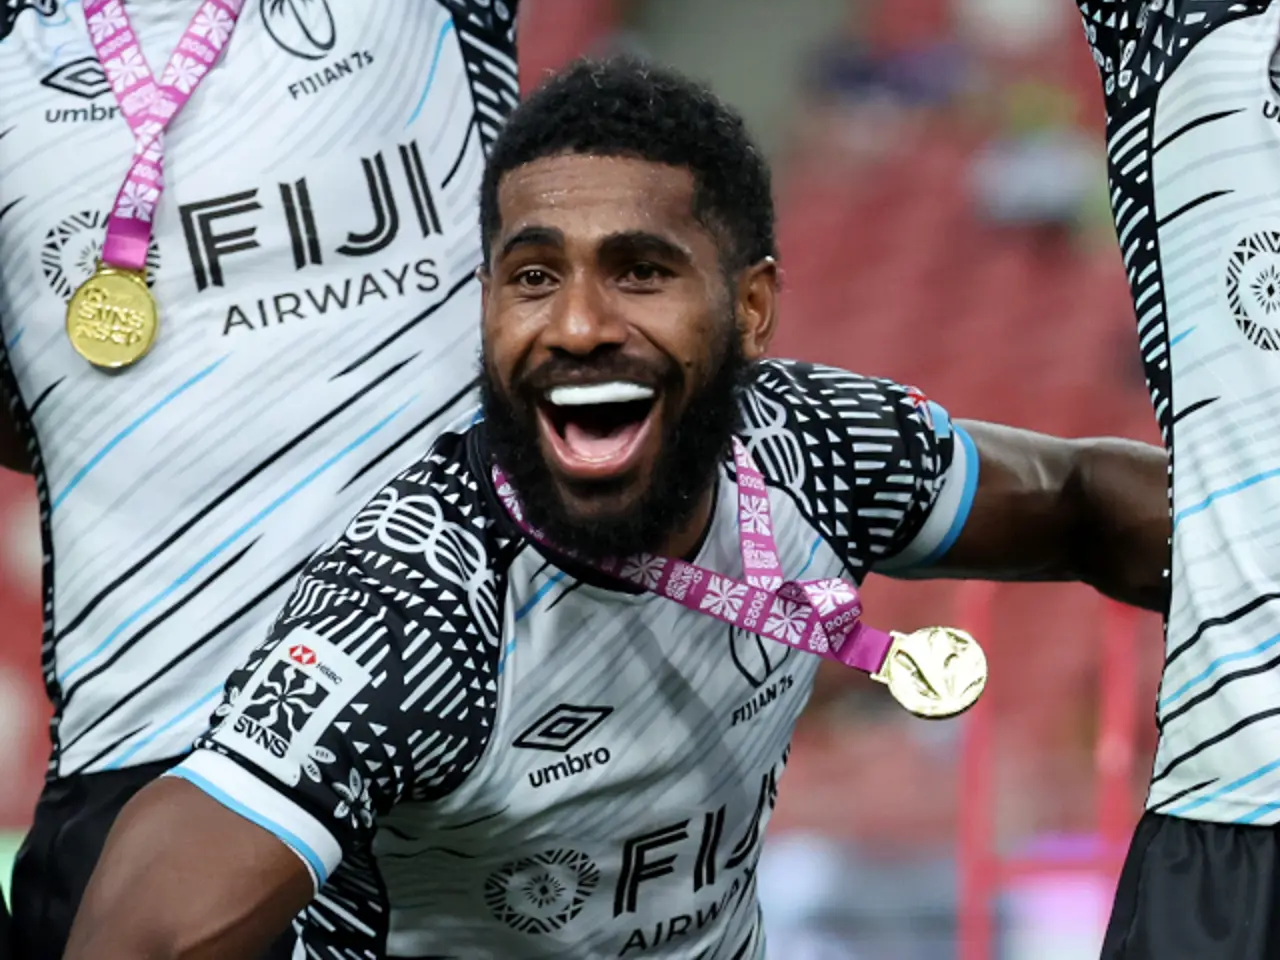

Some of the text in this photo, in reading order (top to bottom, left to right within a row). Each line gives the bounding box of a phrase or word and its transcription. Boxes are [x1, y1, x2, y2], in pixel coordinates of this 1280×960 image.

[287, 48, 375, 100] FIJIAN 7s
[45, 103, 124, 124] umbr
[179, 139, 444, 291] FIJI
[221, 257, 441, 336] AIRWAYS
[743, 590, 769, 629] 2025
[315, 661, 343, 686] HSBC
[731, 685, 778, 727] FIJIAN
[232, 715, 290, 759] SVNS
[528, 745, 611, 789] umbro
